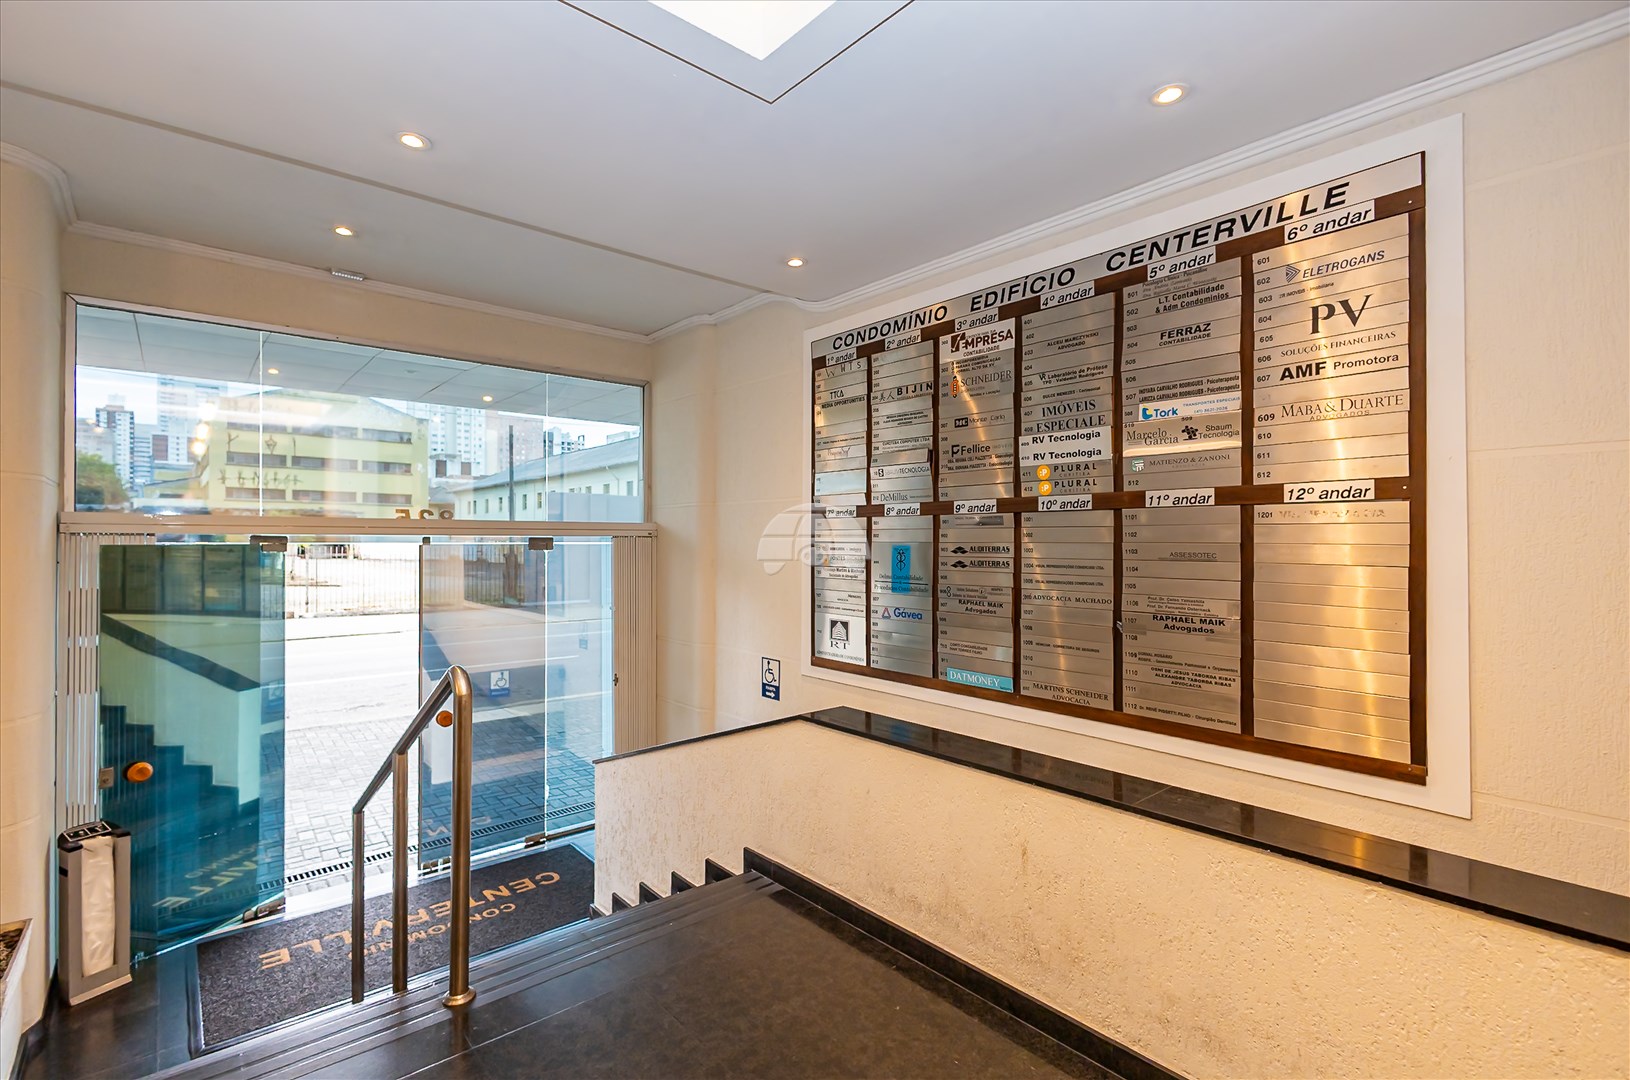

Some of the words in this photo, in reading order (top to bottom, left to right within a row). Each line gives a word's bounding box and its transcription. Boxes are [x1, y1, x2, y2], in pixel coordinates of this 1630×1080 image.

[1288, 224, 1307, 240] 6º
[1313, 209, 1371, 234] andar
[833, 305, 947, 350] CONDOMÍNIO
[970, 268, 1076, 312] EDIFÍCIO
[1106, 182, 1350, 271] CENTERVILLE
[1150, 265, 1165, 278] 5º
[1169, 253, 1213, 273] andar
[1257, 277, 1270, 285] 602
[1303, 250, 1385, 278] ELETROGANS
[1042, 295, 1054, 306] 4º
[1058, 287, 1093, 303] andar
[1173, 284, 1224, 301] Contabilidade
[1163, 302, 1178, 312] Adm
[1181, 292, 1229, 308] Condominios
[1259, 295, 1272, 303] 603
[1309, 294, 1373, 334] PV
[957, 321, 967, 330] 3º
[969, 313, 997, 327] andar
[1161, 323, 1211, 340] FERRAZ
[886, 340, 895, 349] 2º
[897, 334, 920, 346] andar
[1058, 341, 1085, 350] ADVOGADO
[1159, 333, 1211, 346] CONTABILIDADE
[1281, 344, 1328, 357] SOLUÇÕES
[1330, 331, 1396, 349] FINANCEIRAS
[963, 345, 999, 357] CONTABILIDADE
[835, 352, 855, 363] andar
[1280, 361, 1326, 381] AMF
[1334, 355, 1399, 370] Promotora
[961, 370, 1012, 387] SCHNEIDER
[1207, 375, 1239, 384] Psicoterapeuta
[897, 383, 932, 395] BIJIN
[1207, 384, 1239, 392] Psicoterapeuta
[1042, 400, 1096, 417] IMÓVEIS
[1154, 407, 1178, 417] Tork
[1258, 414, 1274, 422] 609
[1281, 405, 1322, 418] MABA
[1325, 401, 1337, 413] &
[1340, 394, 1403, 410] DUARTE
[1309, 410, 1370, 420] ADVOGADOS
[1036, 415, 1106, 432] ESPECIALE
[1048, 430, 1100, 442] Tecnologia
[1127, 428, 1167, 440] Marcelo
[1145, 434, 1179, 445] Garcia
[1198, 430, 1239, 438] Tecnologia
[961, 444, 990, 455] Fellice
[1049, 448, 1101, 459] Tecnologia
[1054, 463, 1096, 472] PLURAL
[1149, 458, 1188, 466] MATIENZO
[1055, 479, 1097, 488] PLURAL
[1288, 487, 1314, 500] 12º
[1319, 486, 1370, 499] andar
[1041, 500, 1057, 509] 10º
[1060, 499, 1090, 509] andar
[1149, 494, 1169, 505] 11º
[1173, 494, 1212, 505] andar
[955, 504, 965, 512] 9º
[968, 503, 995, 512] andar
[894, 608, 922, 619] Gávea
[1153, 615, 1196, 624] RAPHAEL
[1164, 624, 1214, 634] Advogados
[950, 671, 999, 686] DATMONEY
[1052, 694, 1090, 705] ADVOCACIA
[1066, 688, 1108, 700] SCHNEIDER
